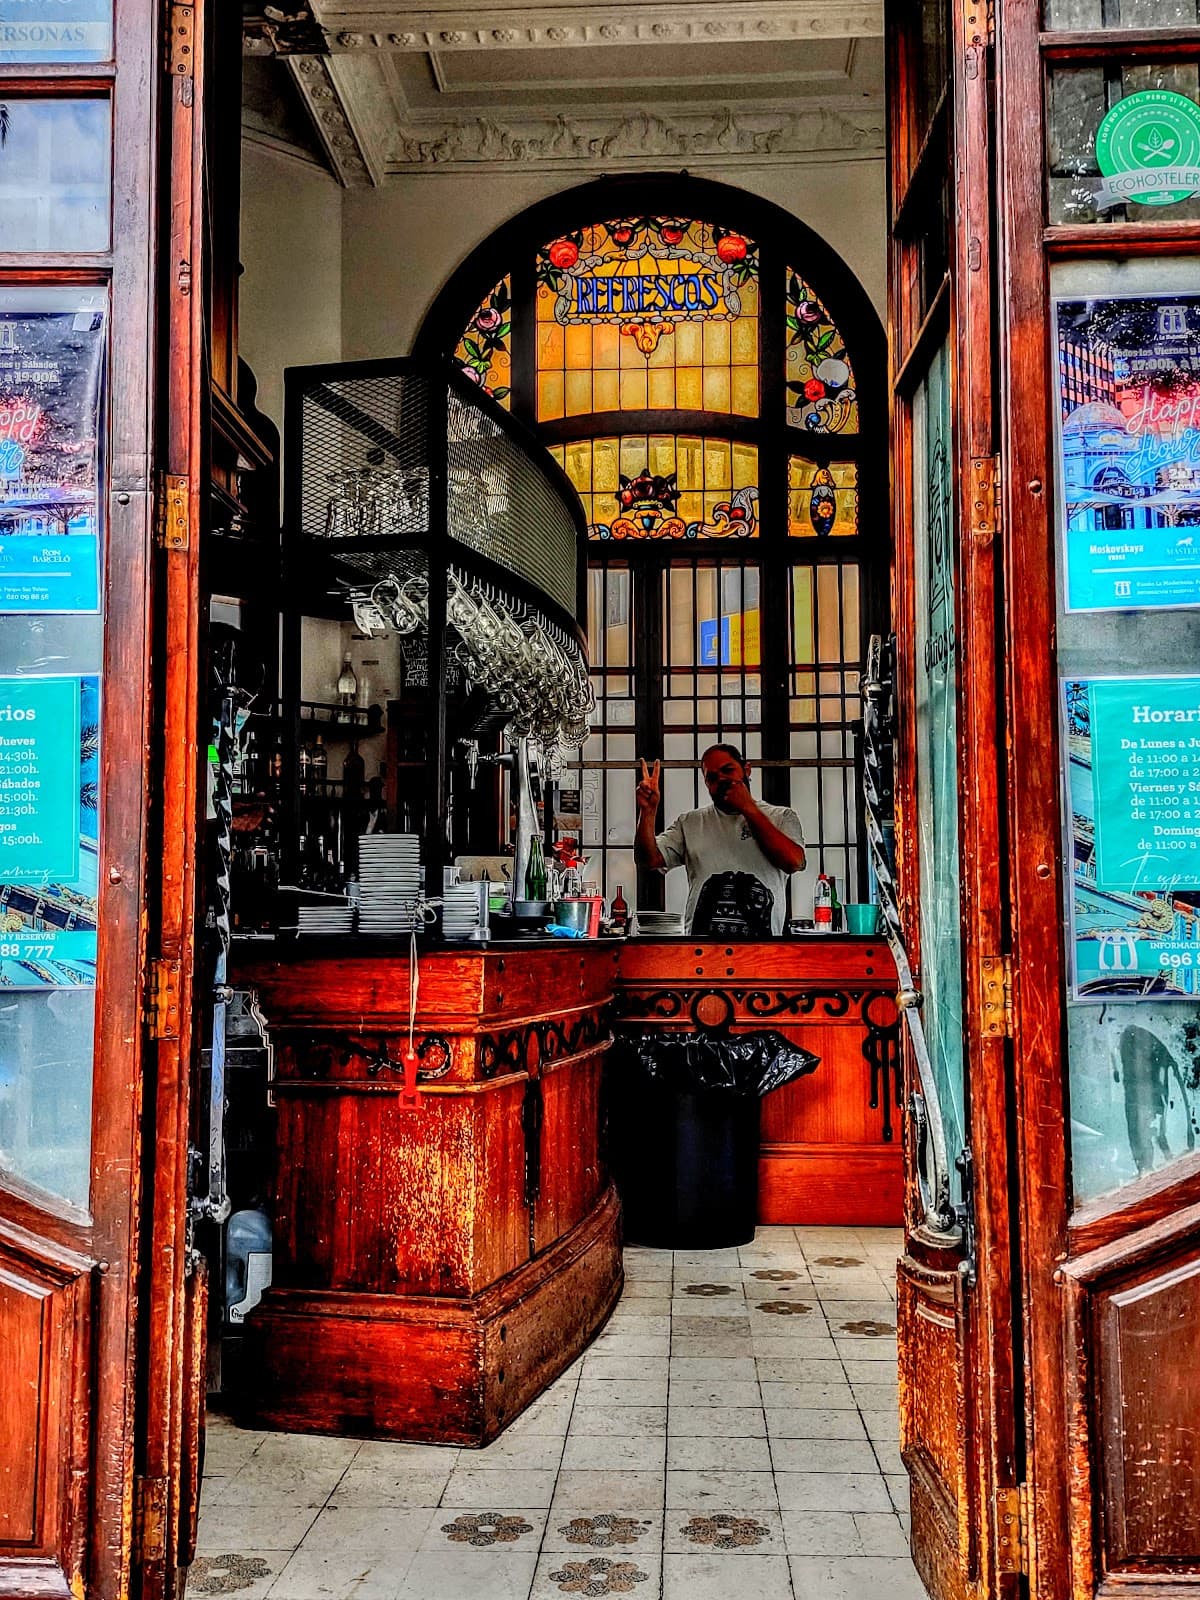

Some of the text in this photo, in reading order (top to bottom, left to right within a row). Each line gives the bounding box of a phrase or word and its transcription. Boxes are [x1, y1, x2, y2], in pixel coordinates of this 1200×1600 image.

[0, 26, 85, 41] RSONAS
[577, 274, 718, 313] REFRESCOS
[1140, 348, 1153, 356] los
[1154, 346, 1188, 355] Viernes
[22, 360, 58, 369] Sábados
[1090, 544, 1144, 554] Moskovskaya
[32, 554, 71, 563] BARCELÓ
[1121, 739, 1138, 749] De
[1140, 739, 1176, 749] Lunes
[1178, 740, 1186, 748] a
[1128, 752, 1144, 764] de
[1147, 754, 1178, 763] 11:00
[1181, 755, 1189, 763] a
[1129, 766, 1145, 778] de
[1147, 768, 1179, 778] 17:00
[1182, 769, 1190, 777] a
[0, 778, 41, 789] ábados
[1129, 783, 1175, 793] Viernes
[1178, 784, 1186, 794] y
[1130, 794, 1200, 806] de 11:00 a 1
[1131, 808, 1147, 820] de
[1150, 809, 1181, 820] 17:00
[2, 832, 43, 846] 15:00h.
[1137, 838, 1197, 850] de 11:00 a
[7, 933, 14, 941] Y
[16, 933, 55, 941] RESERVAS
[24, 945, 54, 959] 777
[1159, 952, 1192, 968] 696
